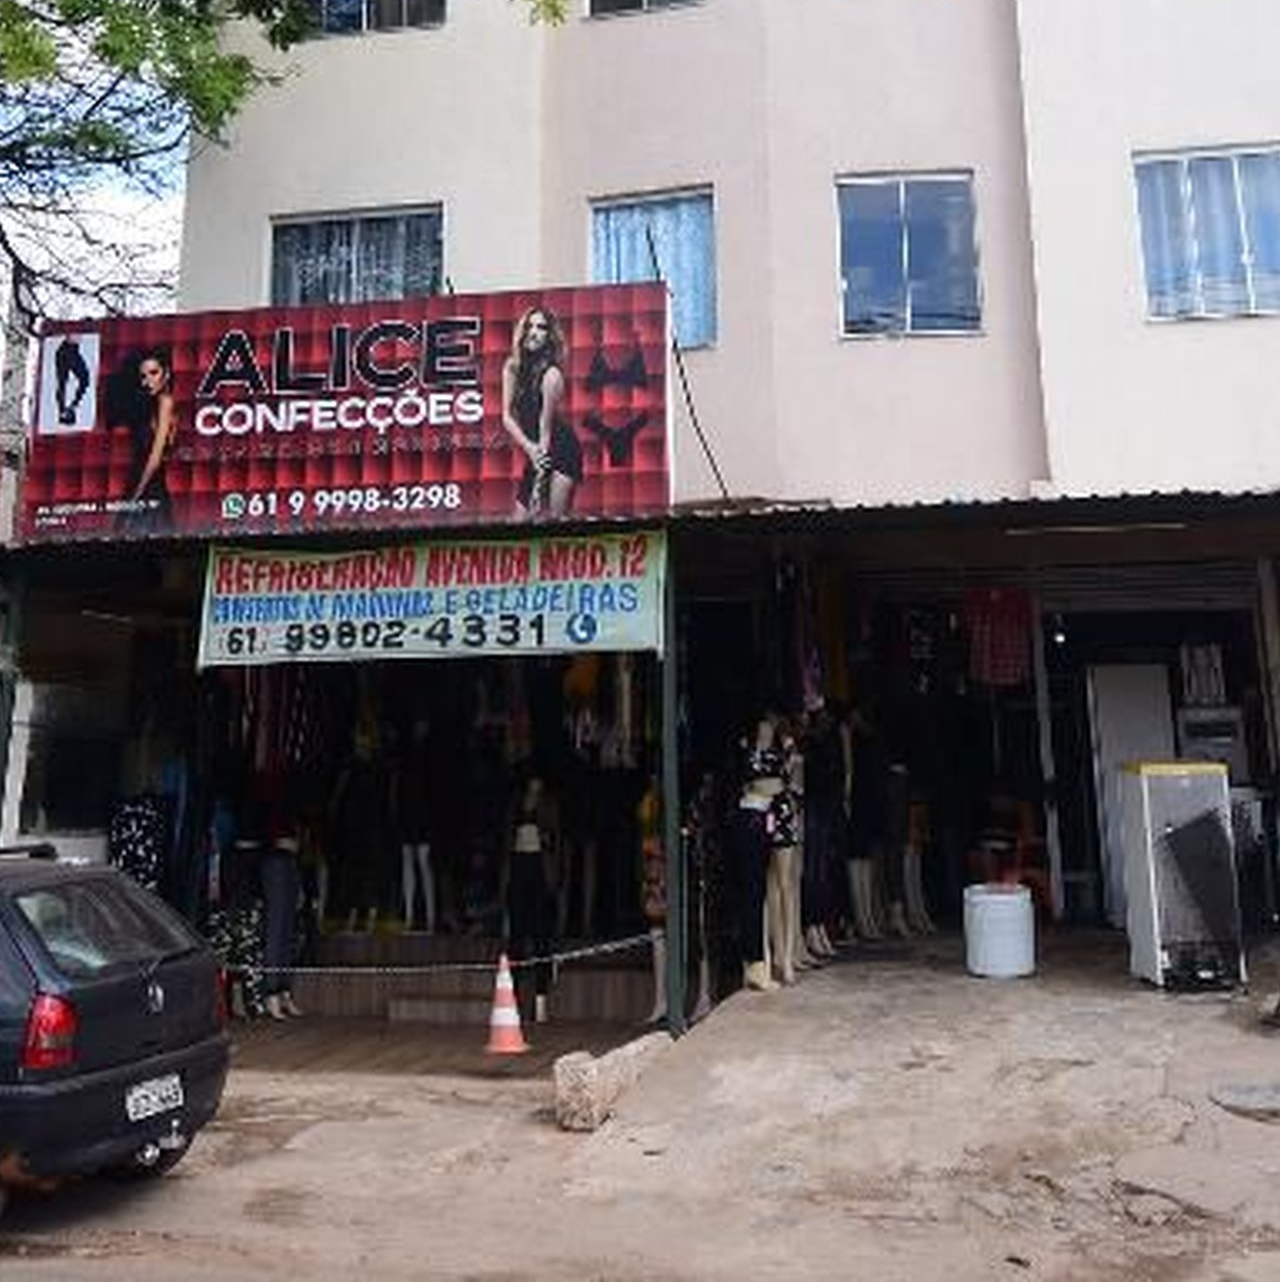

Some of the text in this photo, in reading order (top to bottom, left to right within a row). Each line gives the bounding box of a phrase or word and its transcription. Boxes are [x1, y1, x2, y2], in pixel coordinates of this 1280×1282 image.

[195, 316, 481, 398] ALICE
[194, 388, 484, 435] CONFECÇÕES
[248, 483, 462, 517] 61 9 9998-3298
[445, 590, 459, 615] E
[464, 582, 639, 615] GELADEIRAS
